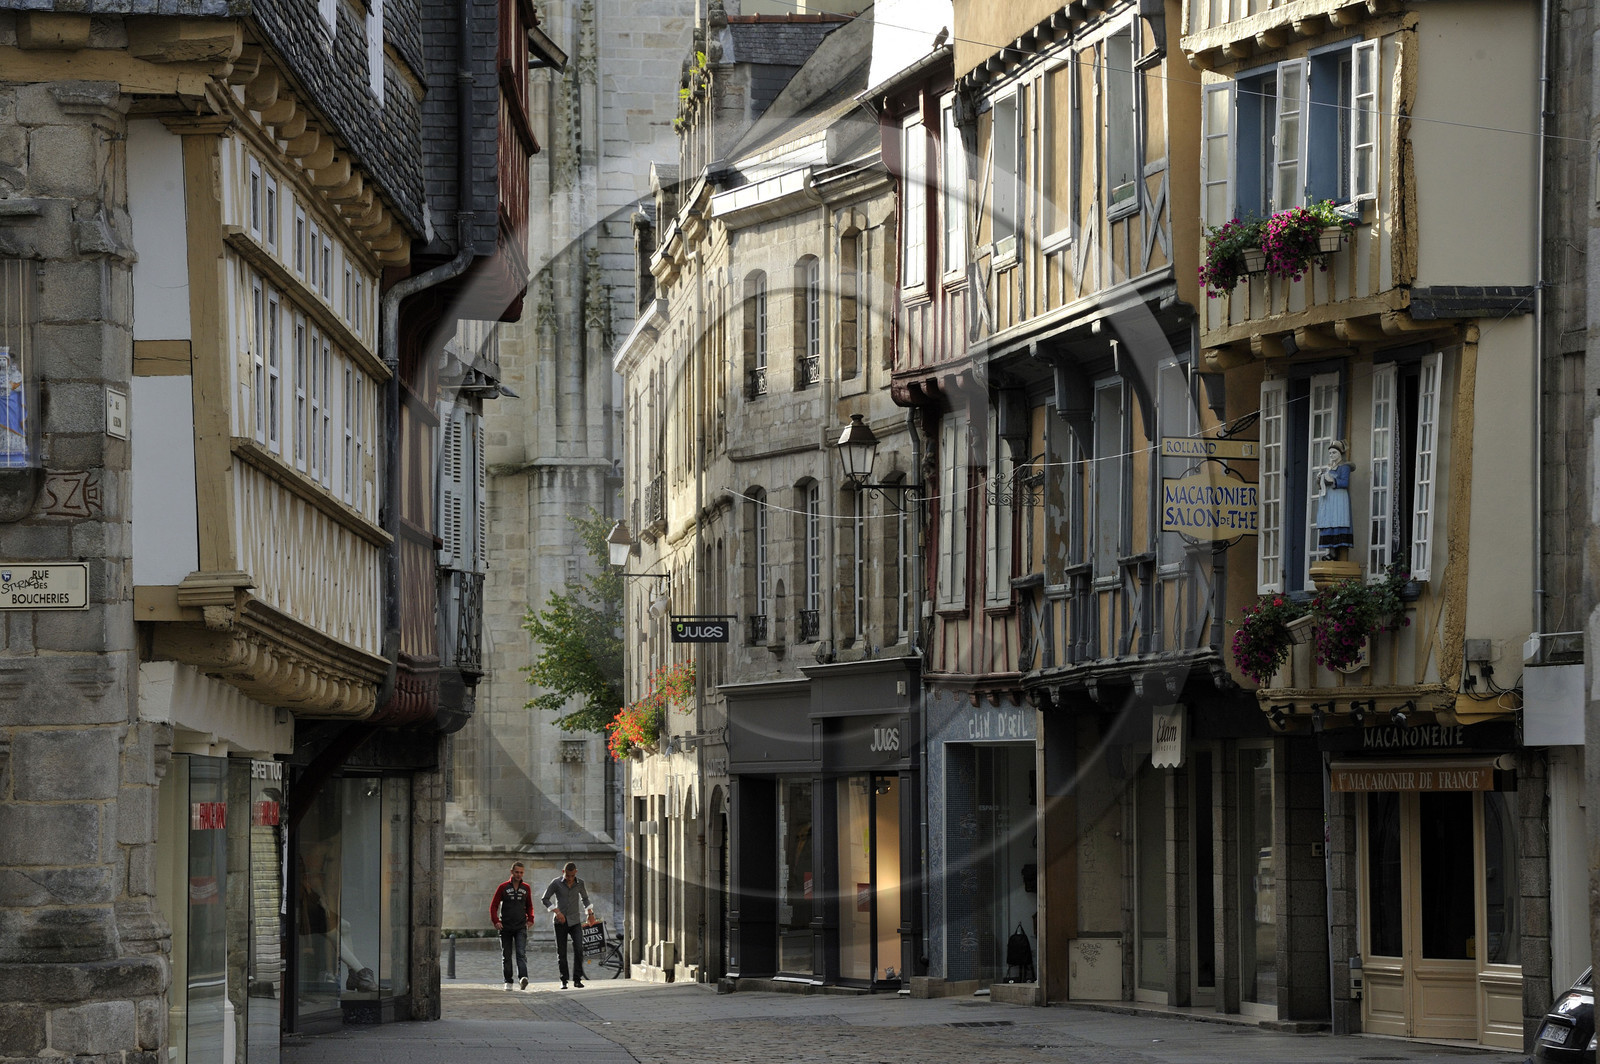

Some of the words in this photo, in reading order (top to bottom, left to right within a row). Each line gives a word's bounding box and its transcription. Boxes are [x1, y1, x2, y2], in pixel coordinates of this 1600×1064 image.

[1166, 441, 1217, 454] ROLLAND
[1165, 486, 1257, 506] MACARONIER
[1164, 506, 1220, 527] SALON
[1220, 516, 1230, 525] DE
[1228, 510, 1258, 530] THE
[32, 570, 49, 579] RUE
[12, 593, 70, 604] BOUCHERIES
[678, 626, 723, 638] JULES
[1156, 716, 1177, 743] Etam
[1363, 726, 1464, 748] MACARONERIE
[870, 728, 899, 752] JULES
[1349, 772, 1415, 790] MACARONIER
[1418, 772, 1433, 789] DE
[1438, 771, 1479, 789] FRANCE
[582, 927, 599, 936] LIVRES
